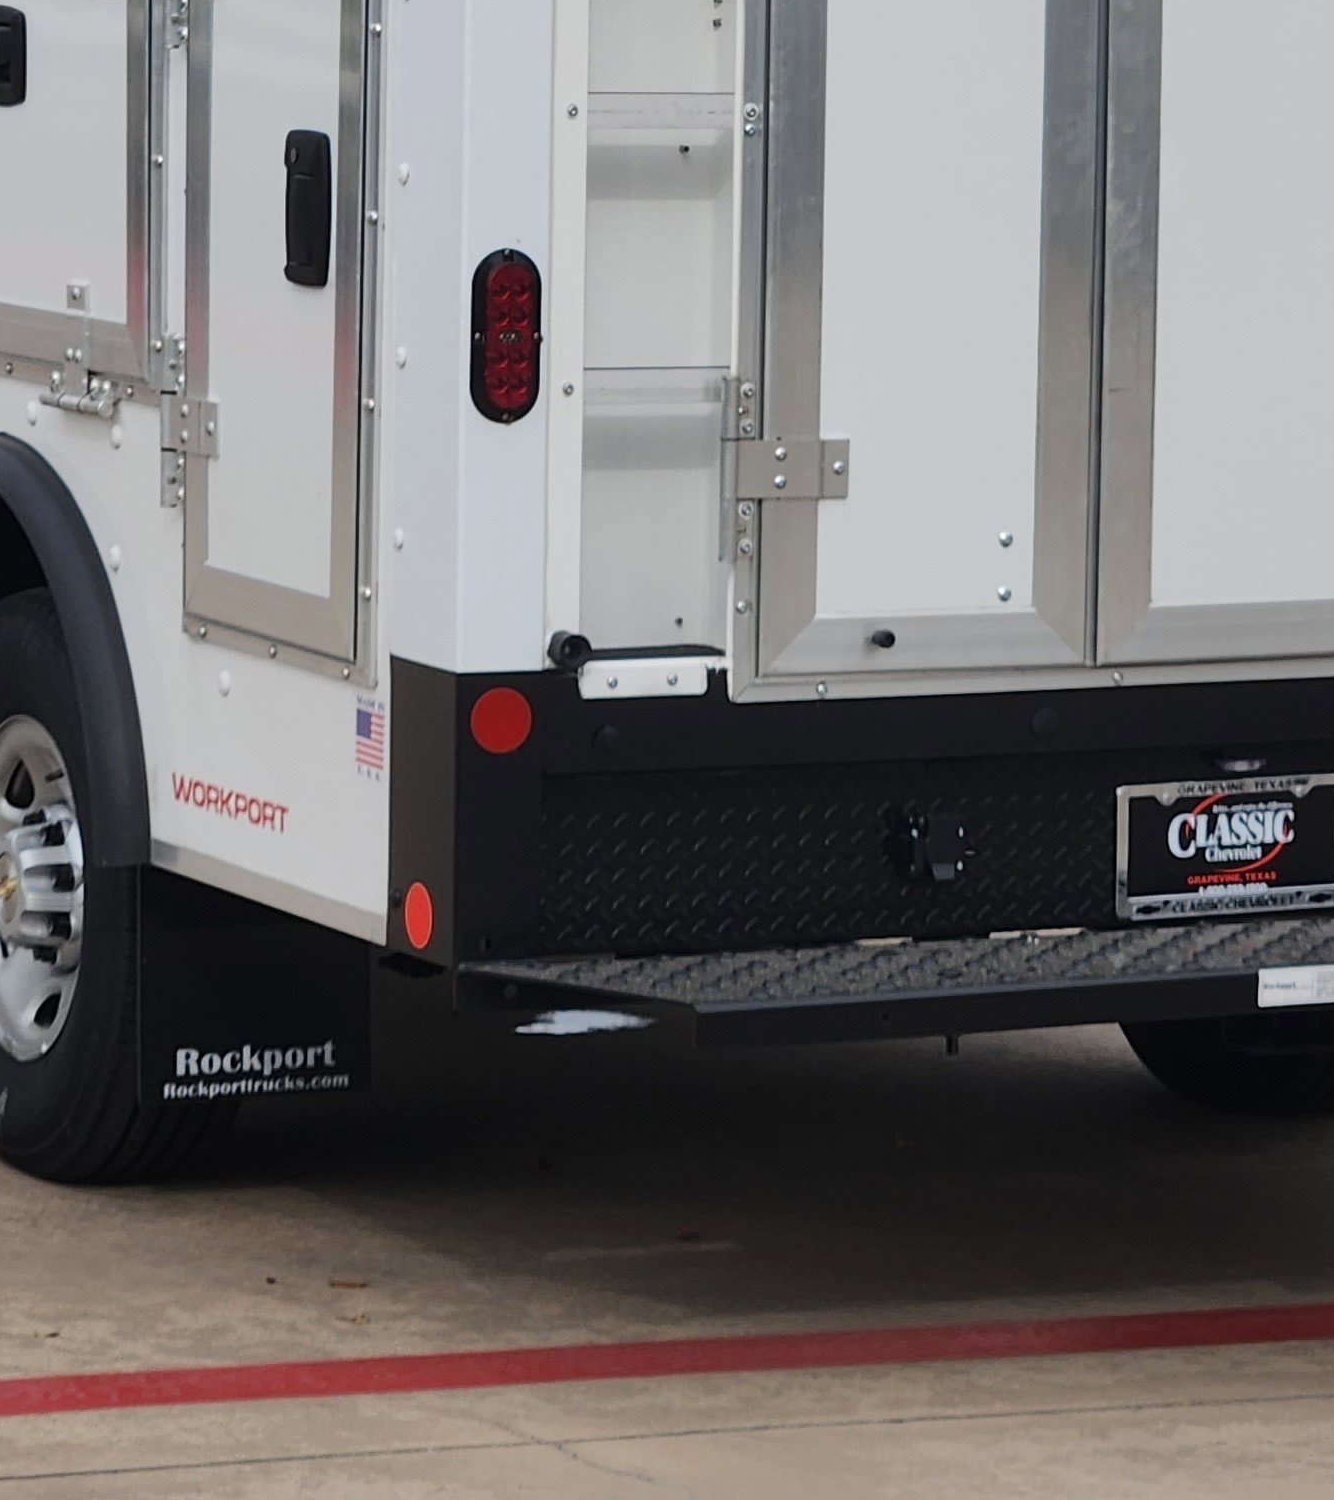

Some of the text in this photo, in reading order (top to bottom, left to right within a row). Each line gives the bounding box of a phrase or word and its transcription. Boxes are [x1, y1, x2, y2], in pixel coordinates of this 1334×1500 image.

[171, 772, 290, 833] WORKPORT
[1168, 811, 1295, 858] CLASSIC
[1205, 843, 1262, 862] Chevrolet
[1245, 870, 1277, 881] TEXAS
[175, 1040, 336, 1077] Rockport
[163, 1074, 350, 1100] Rockporttrucks.com
